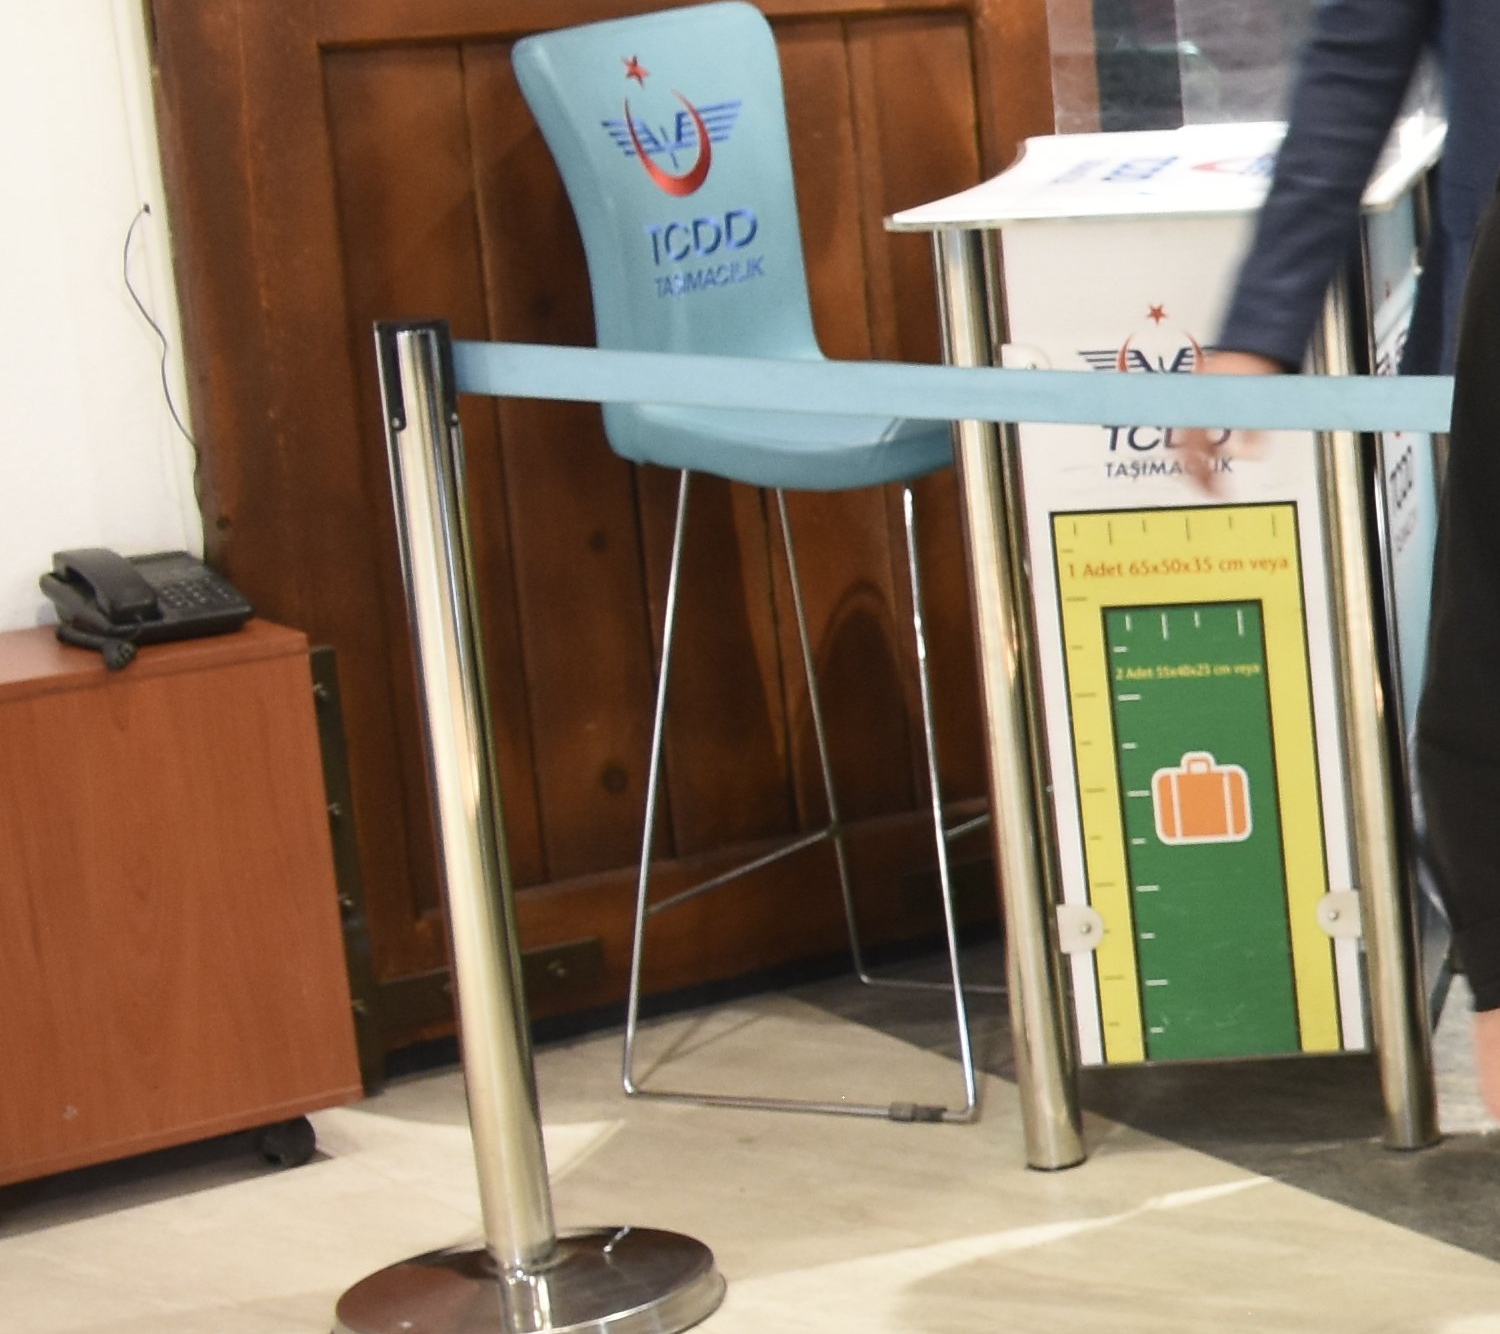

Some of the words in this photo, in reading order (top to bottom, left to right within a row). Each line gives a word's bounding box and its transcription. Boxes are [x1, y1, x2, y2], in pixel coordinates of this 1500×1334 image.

[645, 208, 759, 267] TCDD
[1105, 457, 1233, 481] TAŞIMAIK
[1082, 561, 1123, 578] Adet
[1218, 557, 1244, 572] cm
[1249, 556, 1289, 575] veya
